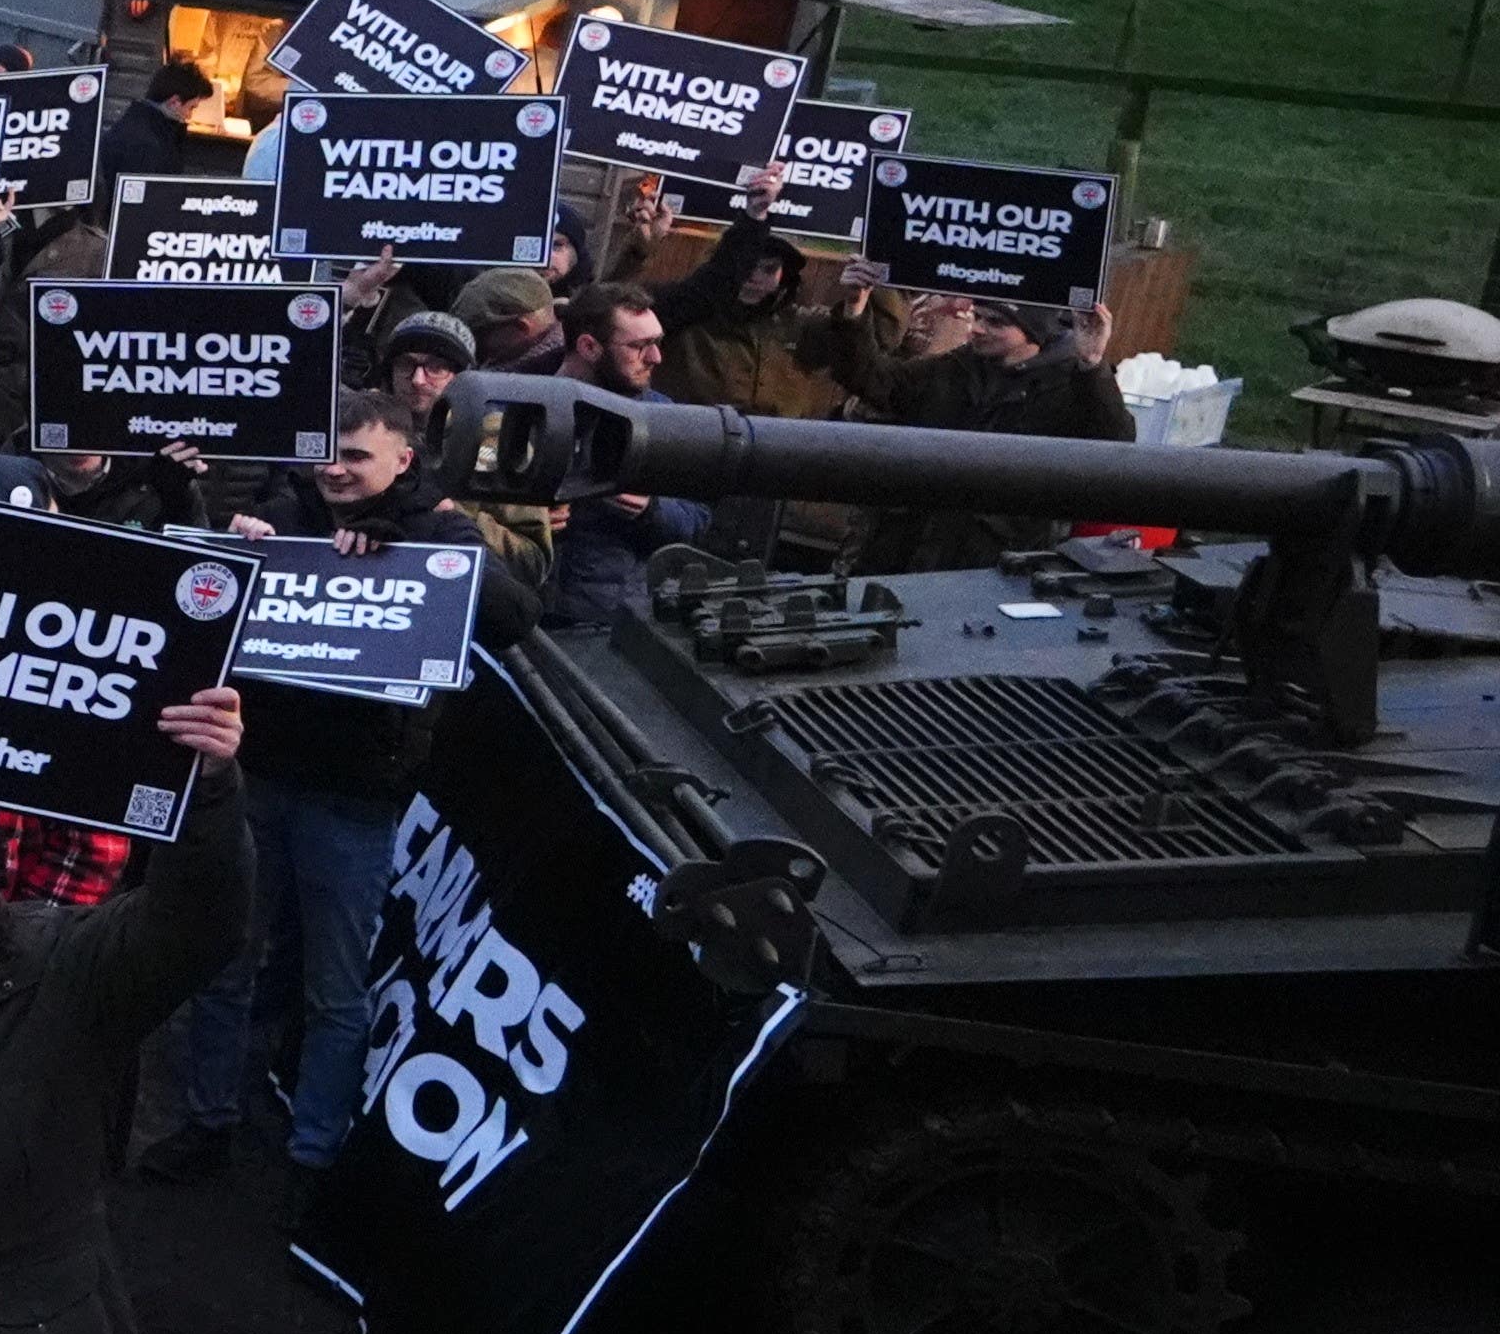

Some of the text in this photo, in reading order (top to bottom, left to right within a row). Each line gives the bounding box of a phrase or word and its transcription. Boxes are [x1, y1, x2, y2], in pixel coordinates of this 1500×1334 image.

[599, 57, 759, 111] WITH OUR
[592, 85, 744, 135] FARMERS
[320, 139, 517, 170] WITH OUR
[617, 132, 700, 160] #together
[324, 171, 504, 203] FARMERS
[902, 193, 1072, 233] WITH OUR
[361, 221, 462, 243] #together
[905, 219, 1061, 258] FARMERS
[937, 263, 1024, 285] #together
[74, 331, 290, 363] WITH OUR
[83, 364, 280, 397] FARMERS
[128, 416, 237, 438] #together
[25, 602, 165, 670] OUR
